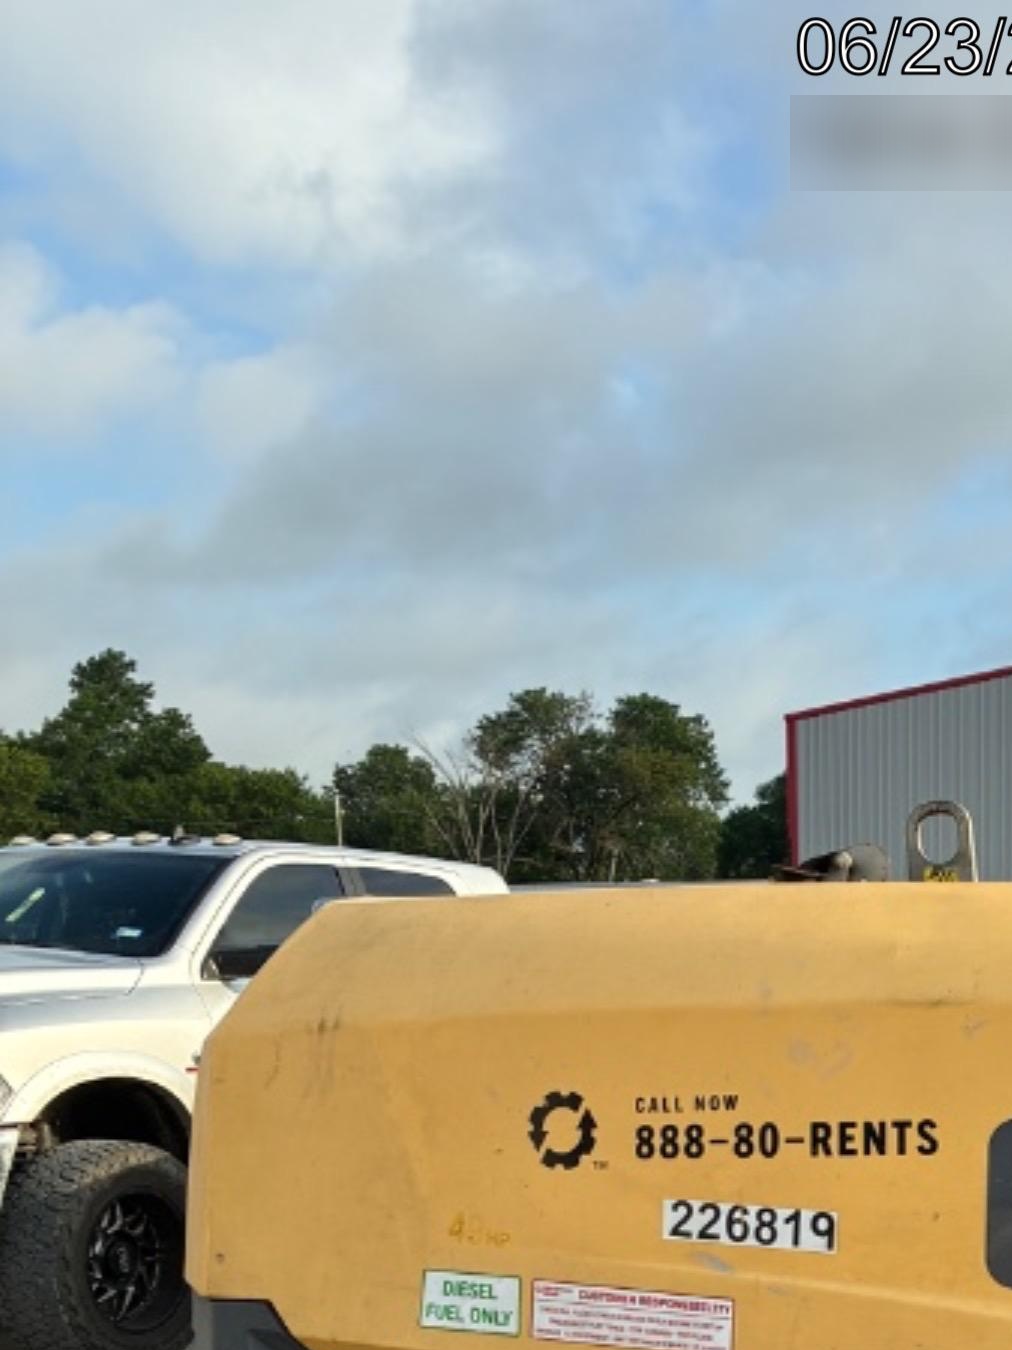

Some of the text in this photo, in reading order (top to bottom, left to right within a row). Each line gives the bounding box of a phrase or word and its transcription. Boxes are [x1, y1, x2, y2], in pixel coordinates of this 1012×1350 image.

[635, 1095, 739, 1114] CALL NOW
[634, 1119, 940, 1160] 888-80-RENTS
[669, 1199, 835, 1251] 226819
[443, 1280, 499, 1300] DIESEL
[425, 1302, 513, 1327] FUEL ONLY
